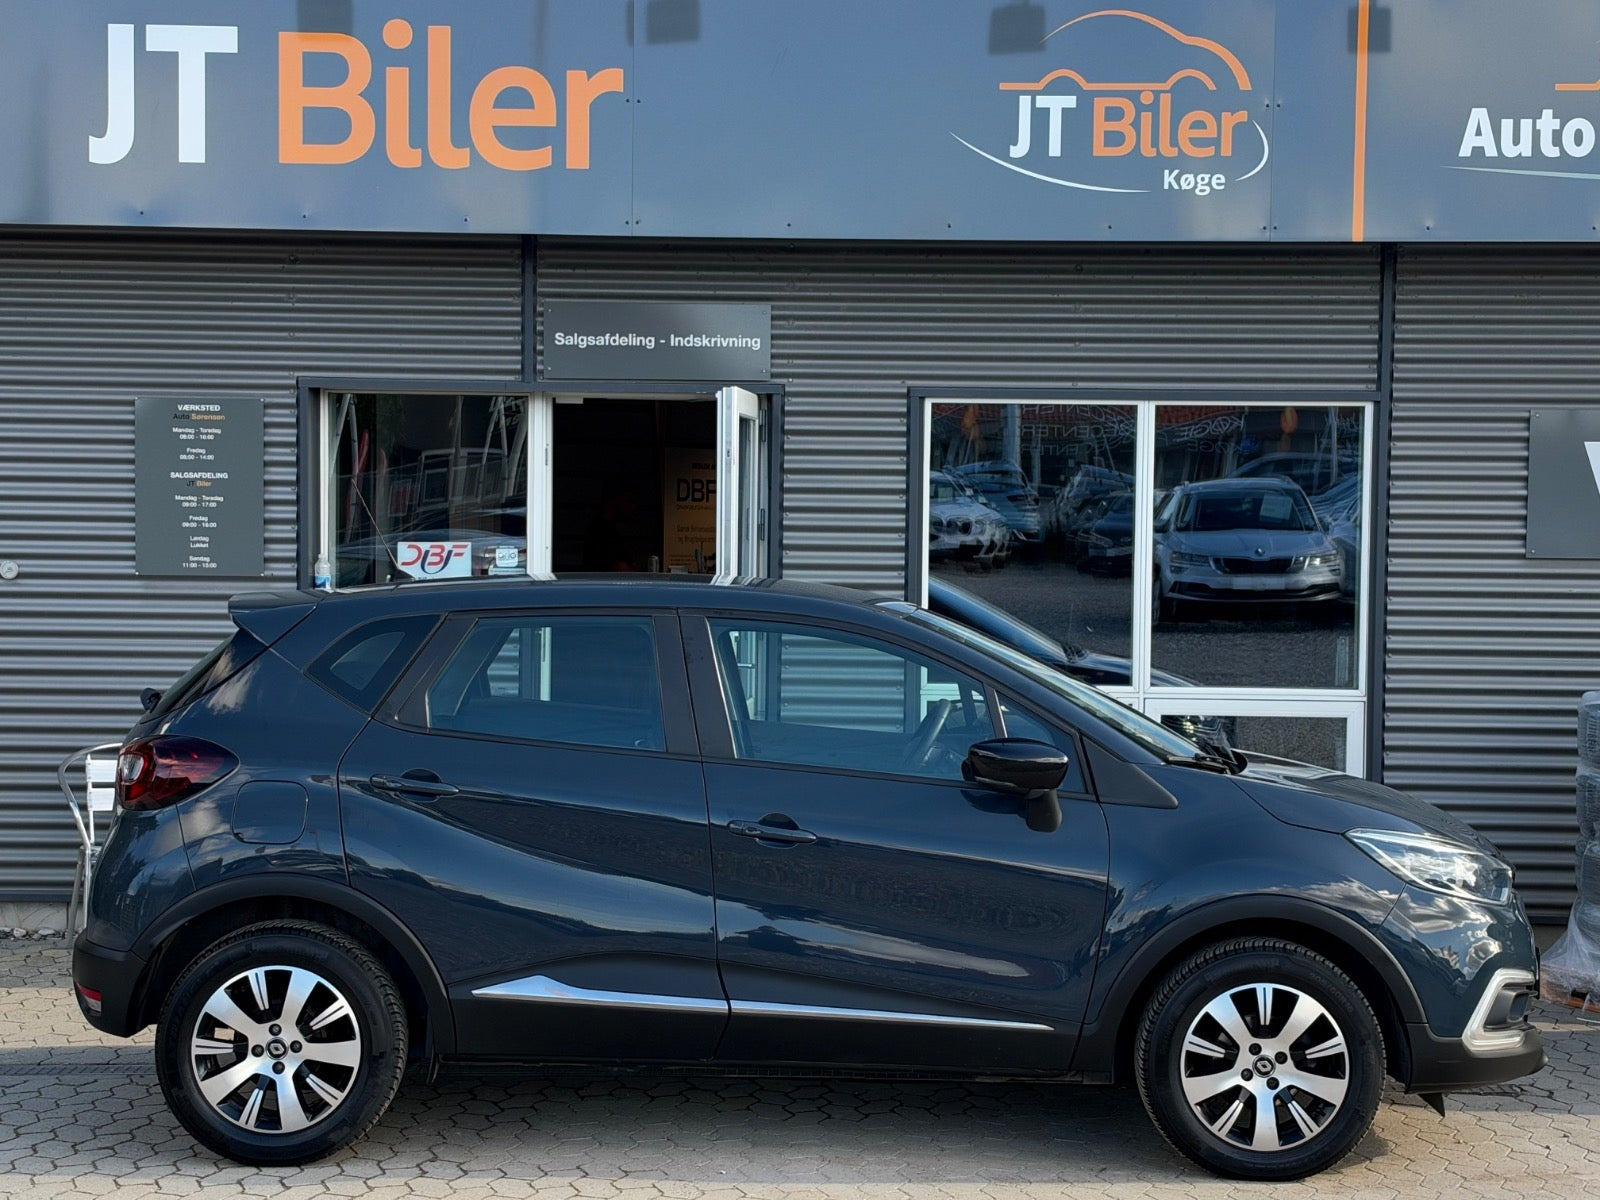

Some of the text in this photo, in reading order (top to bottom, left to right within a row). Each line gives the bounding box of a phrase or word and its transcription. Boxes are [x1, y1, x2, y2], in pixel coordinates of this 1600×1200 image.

[89, 18, 624, 171] JT Biler
[1009, 90, 1248, 158] JT Biler
[1458, 107, 1596, 158] Auto
[1163, 169, 1226, 195] Køge
[554, 333, 655, 349] Salgsafdeling
[670, 334, 761, 350] Indskrivning
[177, 404, 221, 412] VÆRKSTED
